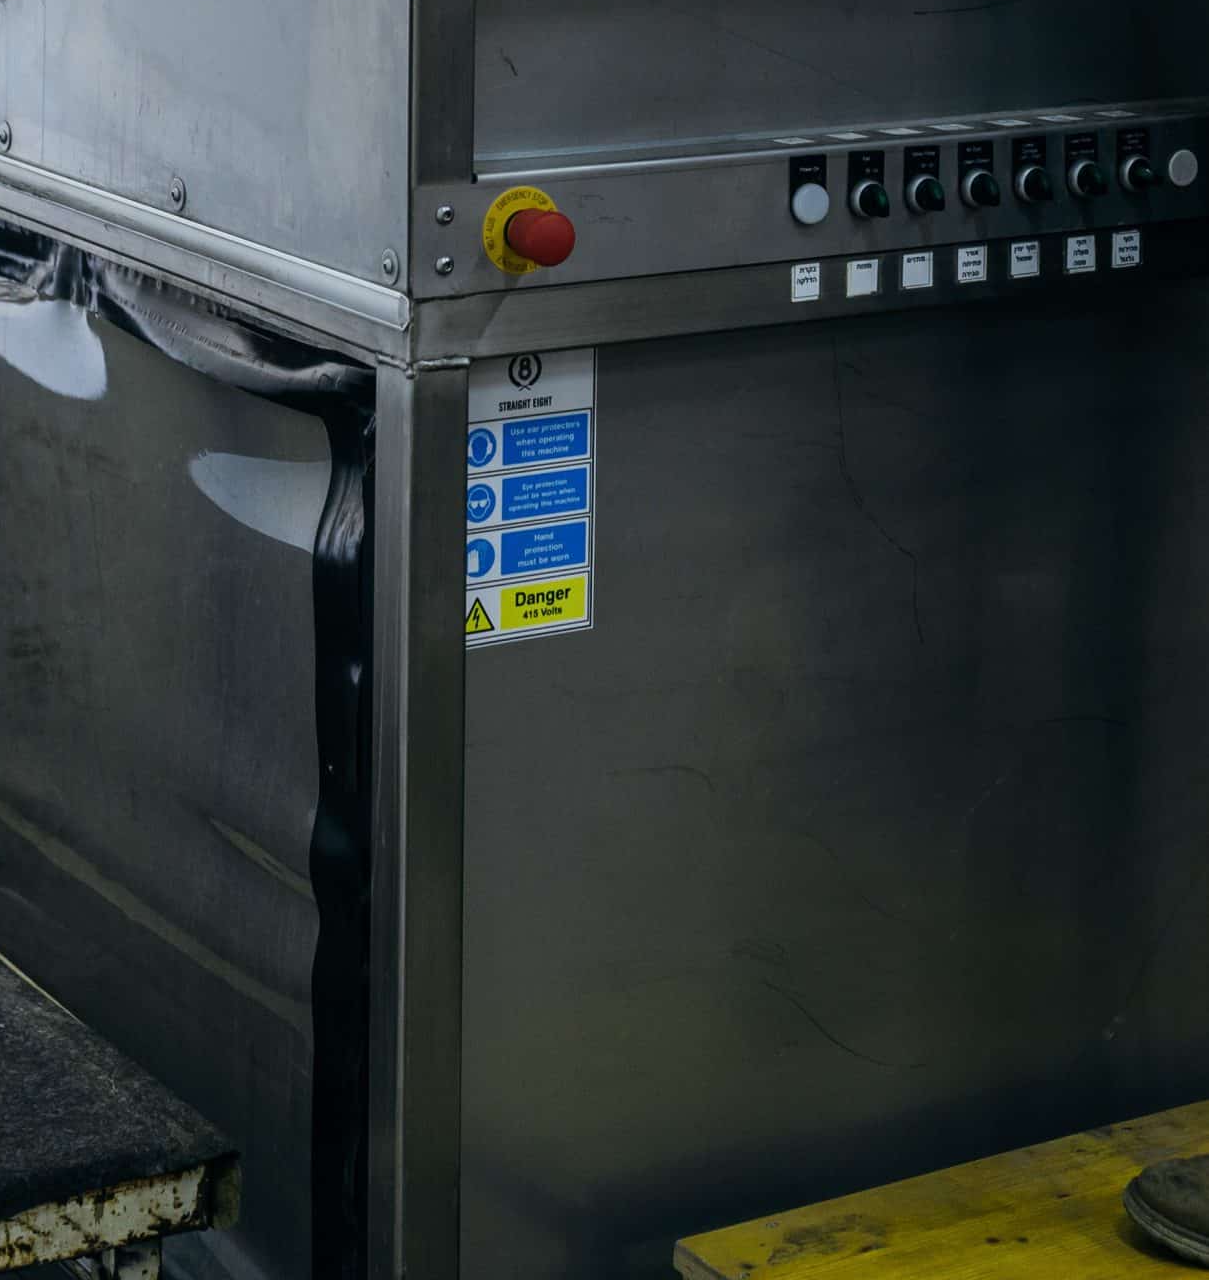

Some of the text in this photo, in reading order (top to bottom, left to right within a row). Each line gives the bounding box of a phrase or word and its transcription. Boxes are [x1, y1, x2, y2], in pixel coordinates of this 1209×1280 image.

[498, 396, 552, 412] STRAIGHT EIGHT
[510, 421, 580, 435] Use ear protectors
[516, 433, 575, 446] when operating
[521, 445, 569, 457] this machine
[522, 479, 568, 492] Eye protection
[514, 487, 576, 501] must be worn when
[508, 501, 539, 512] operating
[554, 496, 580, 505] machine
[534, 532, 554, 542] Hand
[524, 542, 563, 555] protection
[517, 553, 570, 568] must be worn
[515, 587, 571, 607] Danger
[523, 606, 562, 619] 415 Volts
